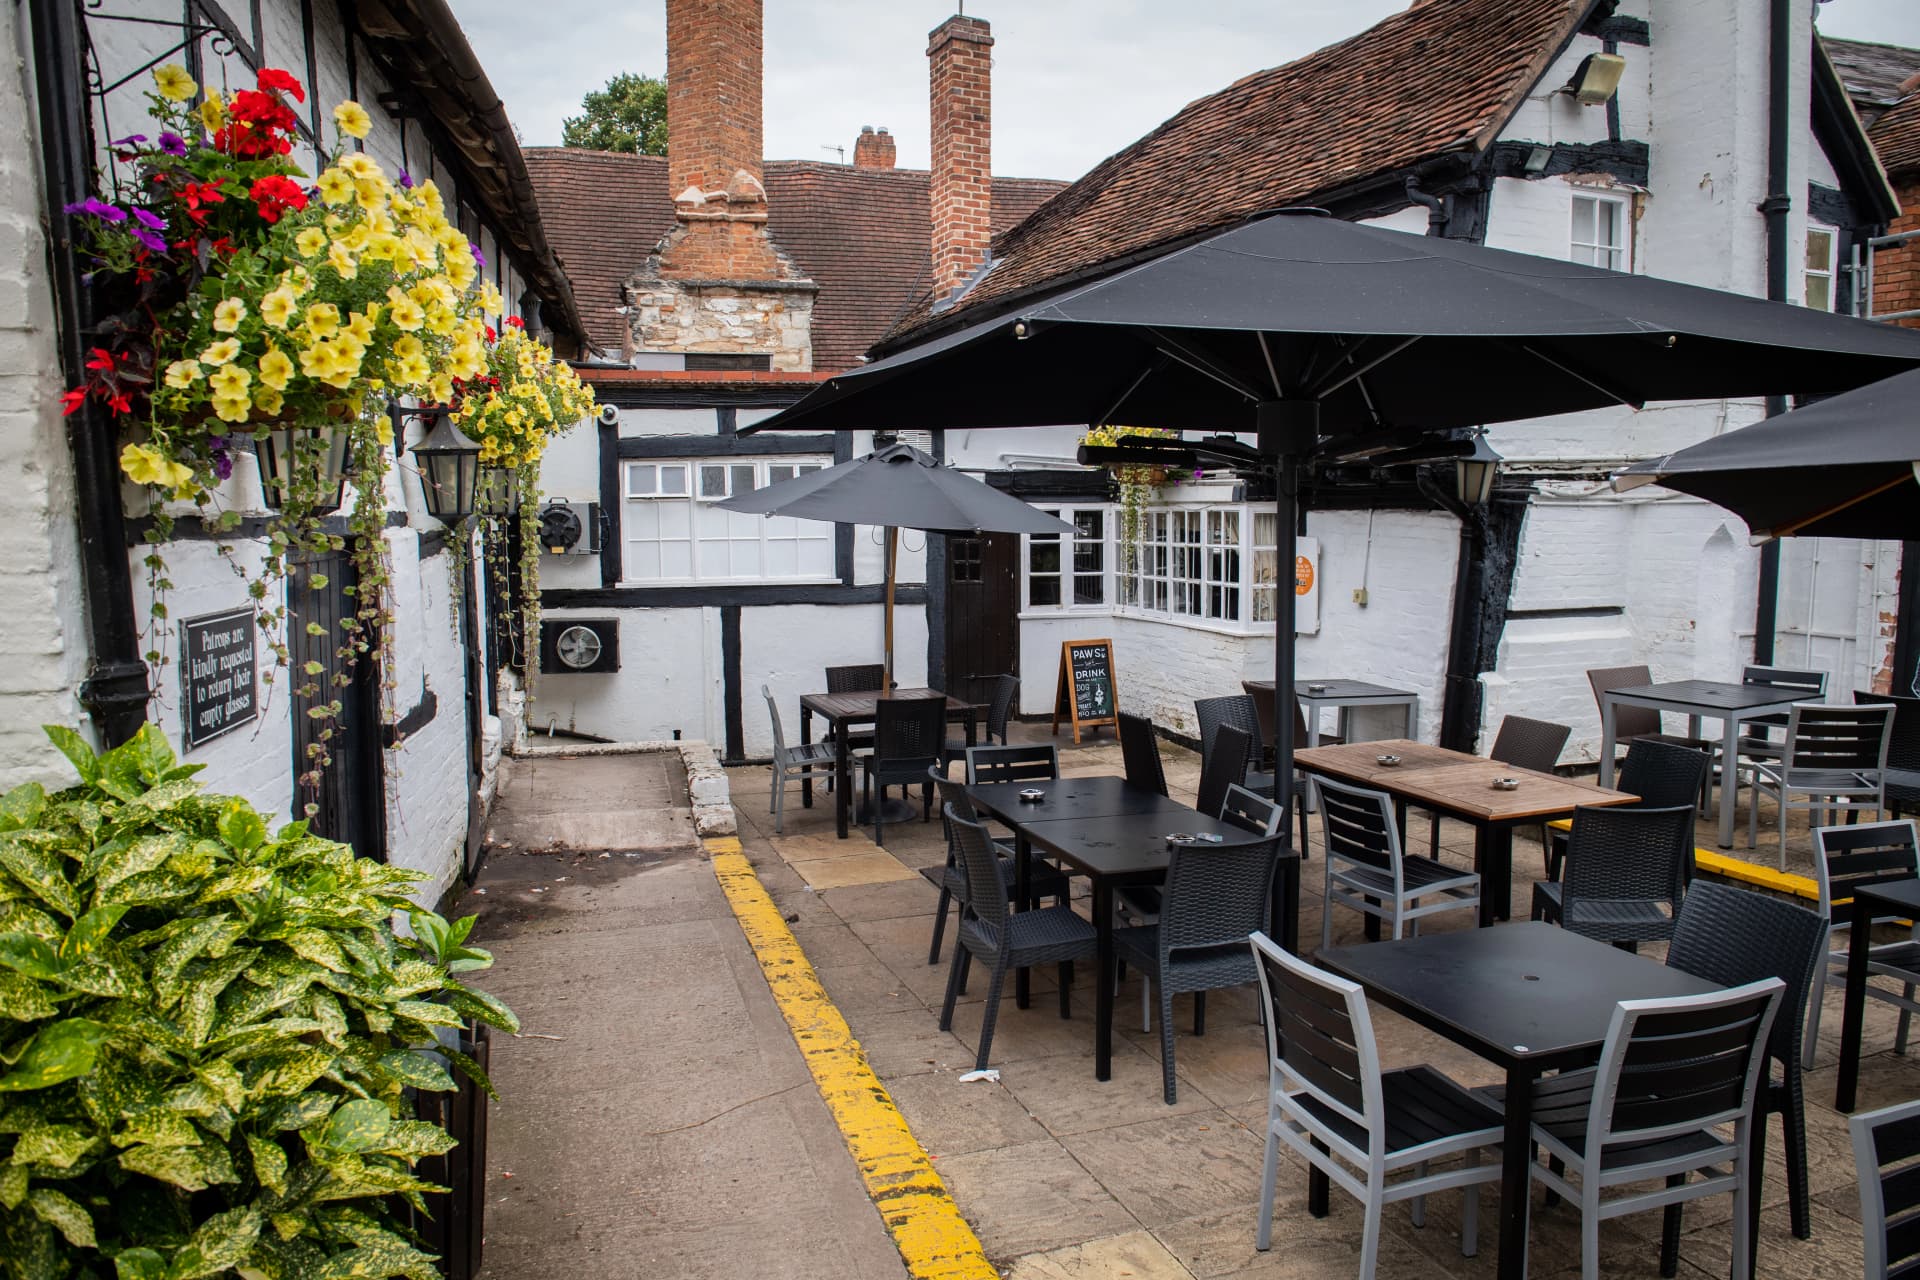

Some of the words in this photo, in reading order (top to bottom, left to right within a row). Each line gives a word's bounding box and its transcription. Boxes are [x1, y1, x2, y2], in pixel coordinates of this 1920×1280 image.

[202, 631, 230, 652] Patrons
[232, 628, 244, 643] are
[192, 653, 218, 680] kindly
[220, 642, 253, 673] requested
[1075, 668, 1106, 679] DRINK
[197, 684, 206, 703] to
[208, 678, 232, 699] return
[234, 668, 251, 691] their
[200, 704, 223, 728] empty
[226, 693, 250, 721] glasses
